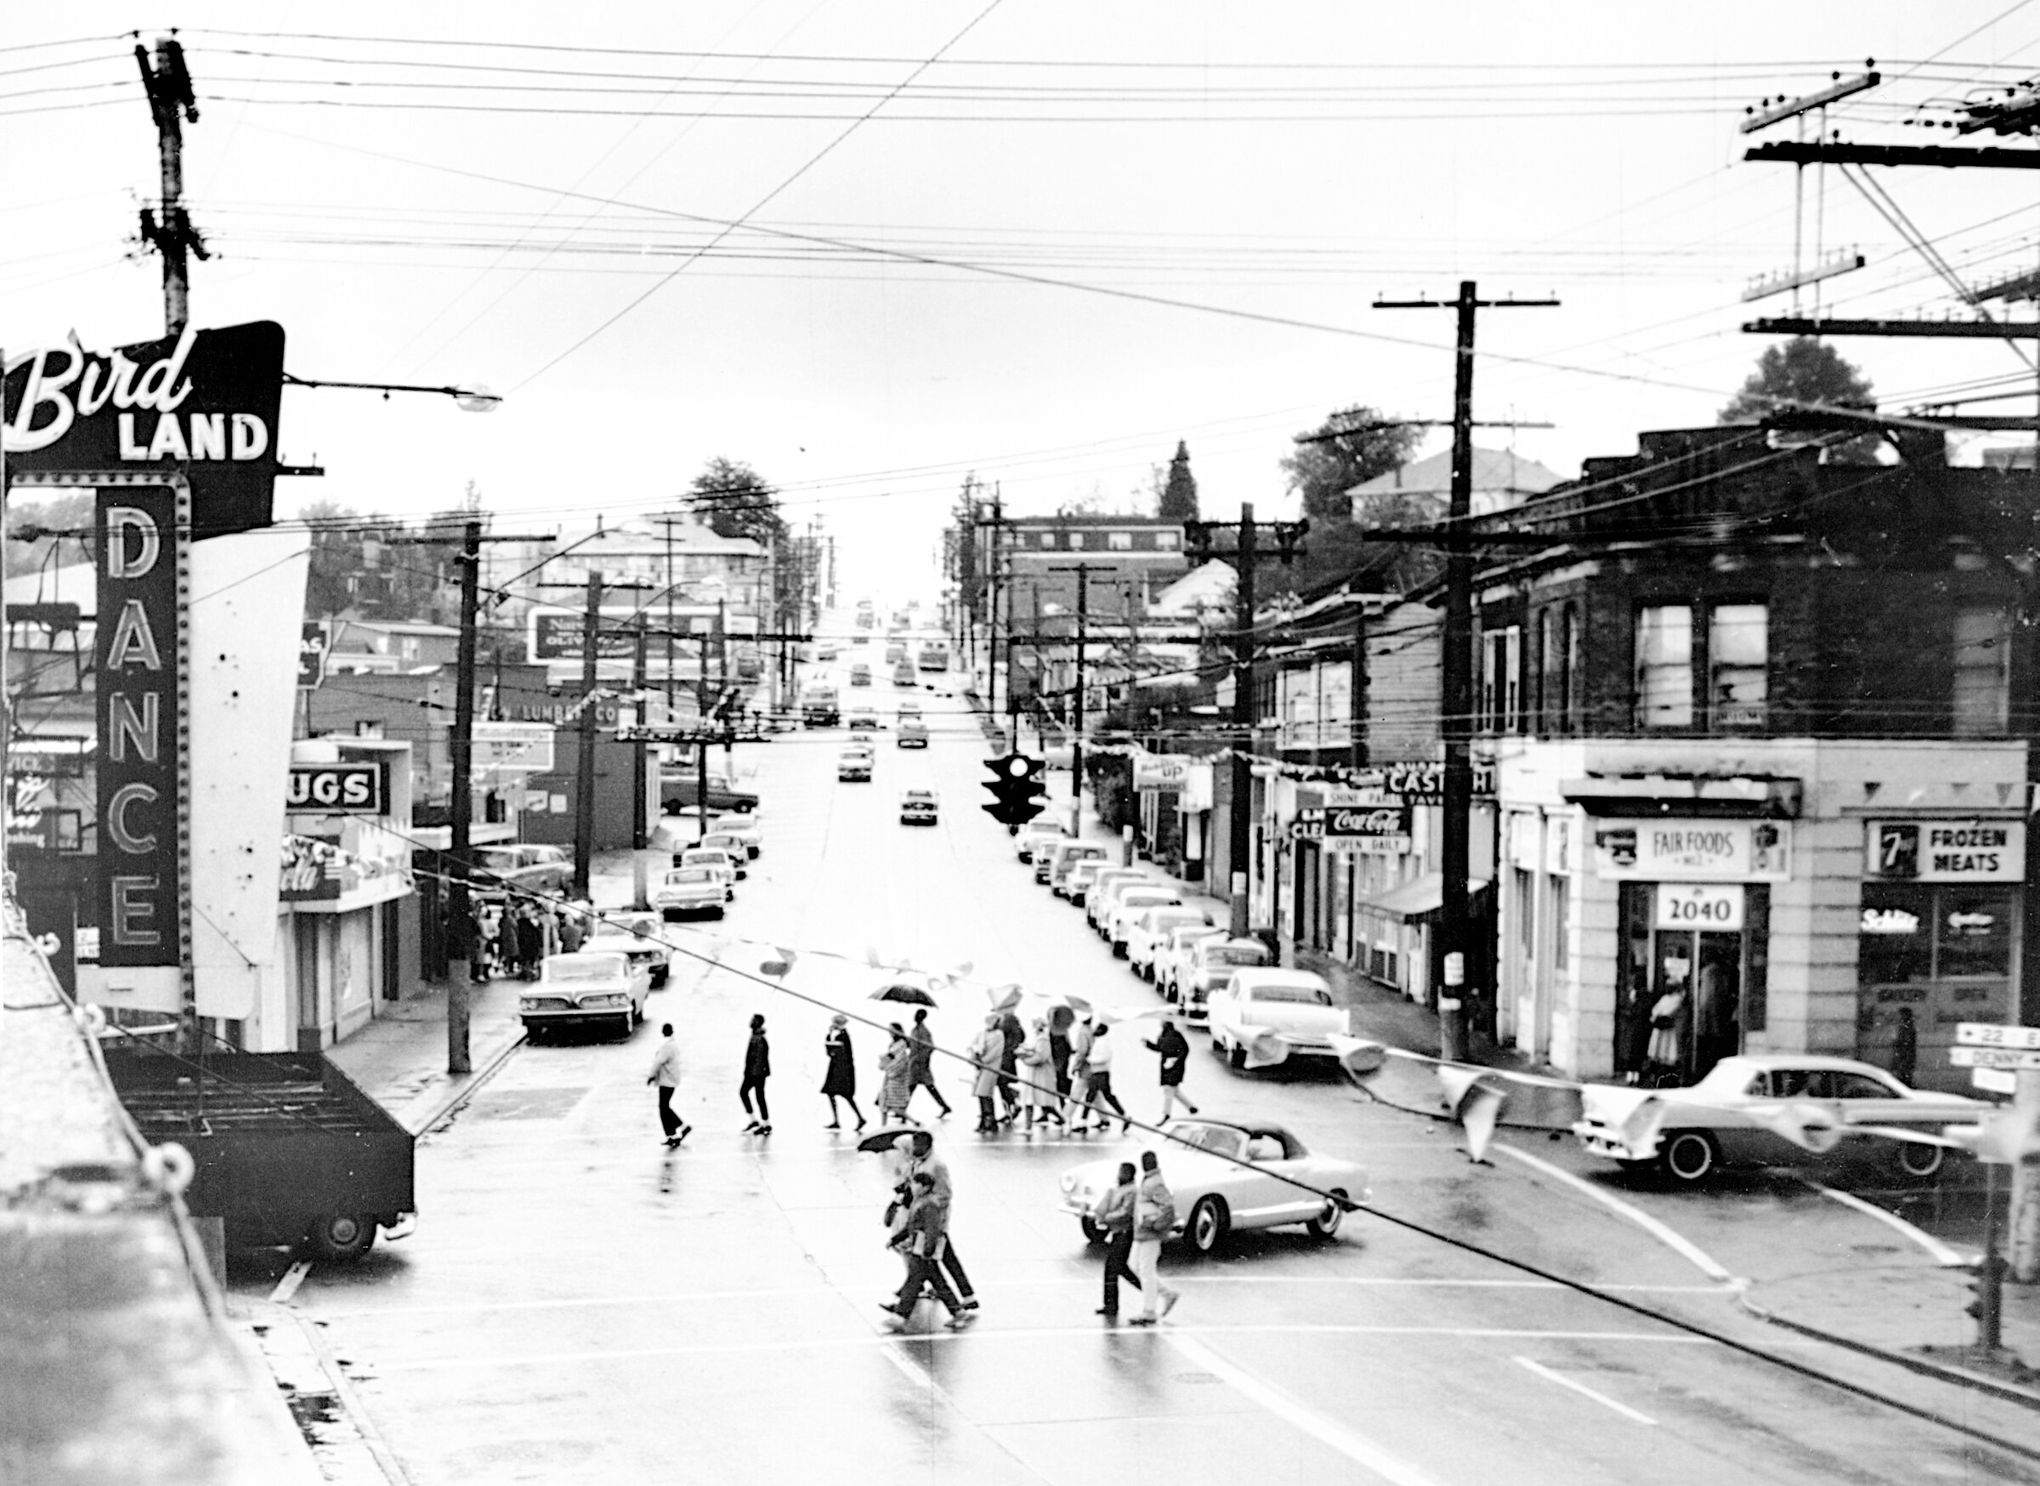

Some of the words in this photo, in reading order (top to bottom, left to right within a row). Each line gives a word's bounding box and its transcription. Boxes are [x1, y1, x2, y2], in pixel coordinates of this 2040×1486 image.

[4, 326, 198, 452] Bird
[118, 412, 269, 462] LAND
[595, 706, 617, 721] CO
[104, 506, 163, 945] DANCE
[1335, 839, 1363, 851] OPEN
[1372, 839, 1400, 851] DAILY
[1653, 831, 1684, 857] FAIR
[1686, 830, 1735, 858] FOODS
[1930, 829, 2008, 848] FROZEN
[1933, 853, 2000, 872] MEATS
[1669, 899, 1732, 921] 2040
[1982, 1028, 2003, 1042] 22
